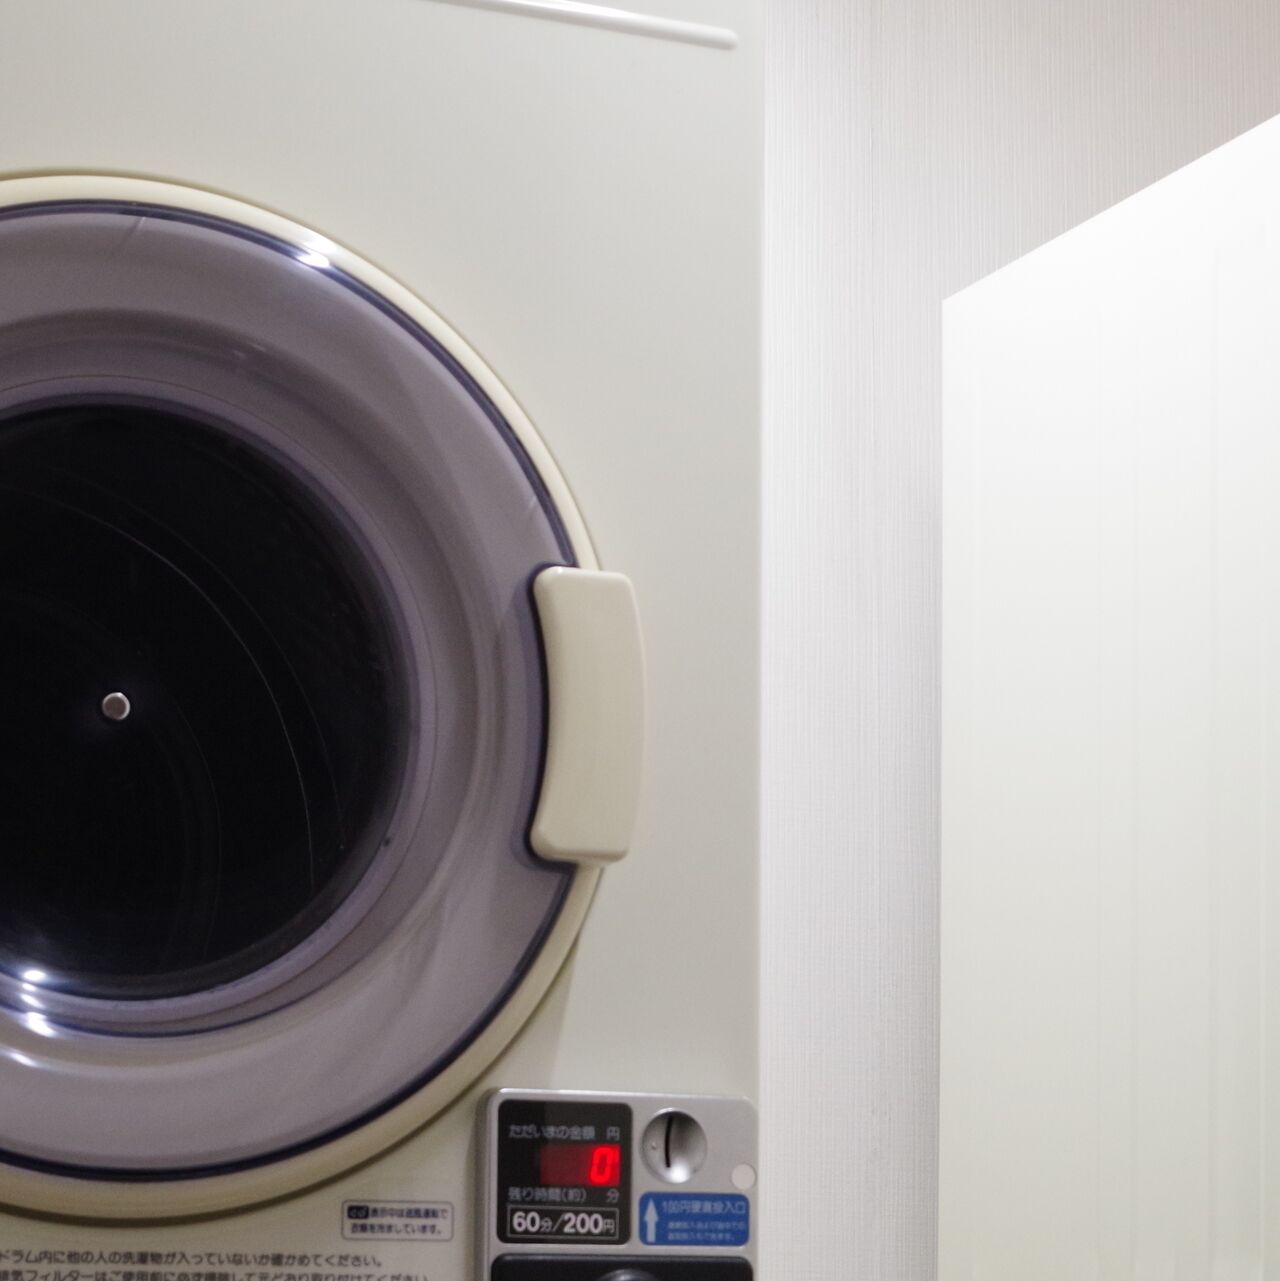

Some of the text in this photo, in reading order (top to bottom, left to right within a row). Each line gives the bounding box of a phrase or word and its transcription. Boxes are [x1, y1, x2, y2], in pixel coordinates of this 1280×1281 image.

[606, 1127, 620, 1139] 円
[590, 1147, 614, 1184] 0
[606, 1190, 620, 1202] 分
